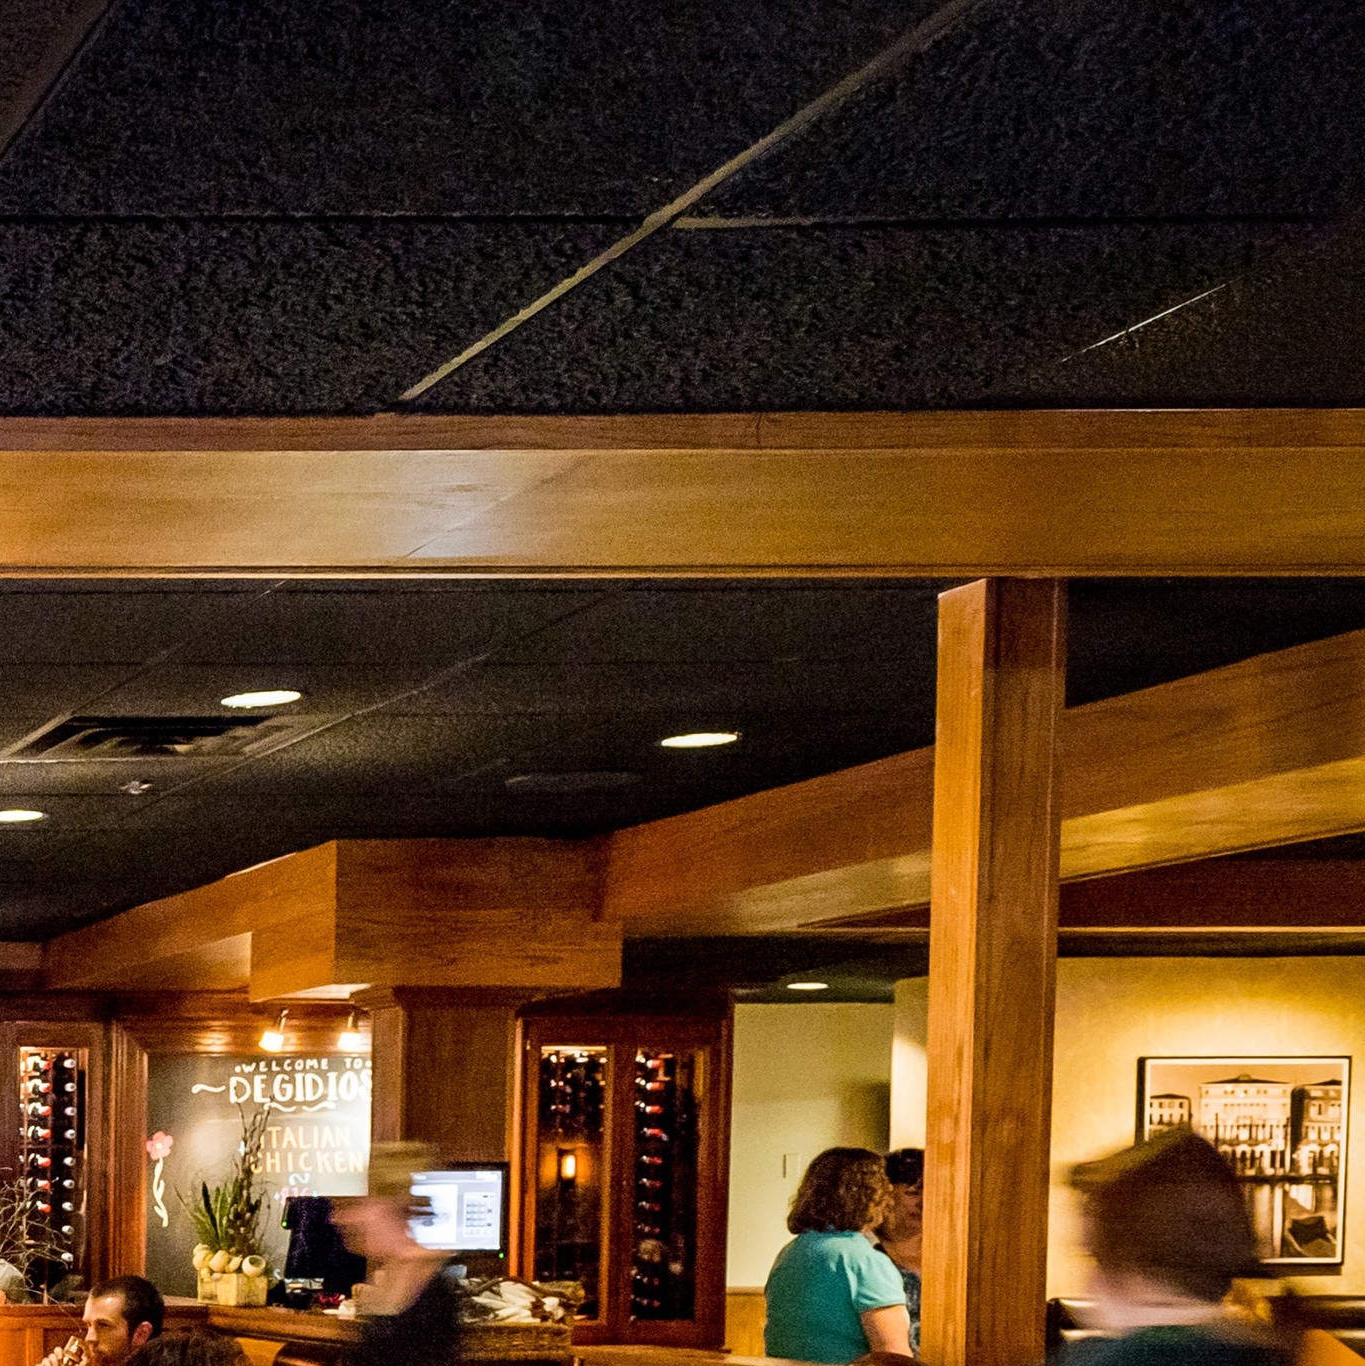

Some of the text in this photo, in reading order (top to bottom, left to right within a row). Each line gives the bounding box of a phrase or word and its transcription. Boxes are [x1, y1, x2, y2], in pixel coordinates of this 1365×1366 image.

[241, 1057, 363, 1074] WELCOME TO
[229, 1069, 373, 1104] DEGIDIOS
[259, 1126, 352, 1149] ITALIAN
[250, 1151, 365, 1174] CHICKEN
